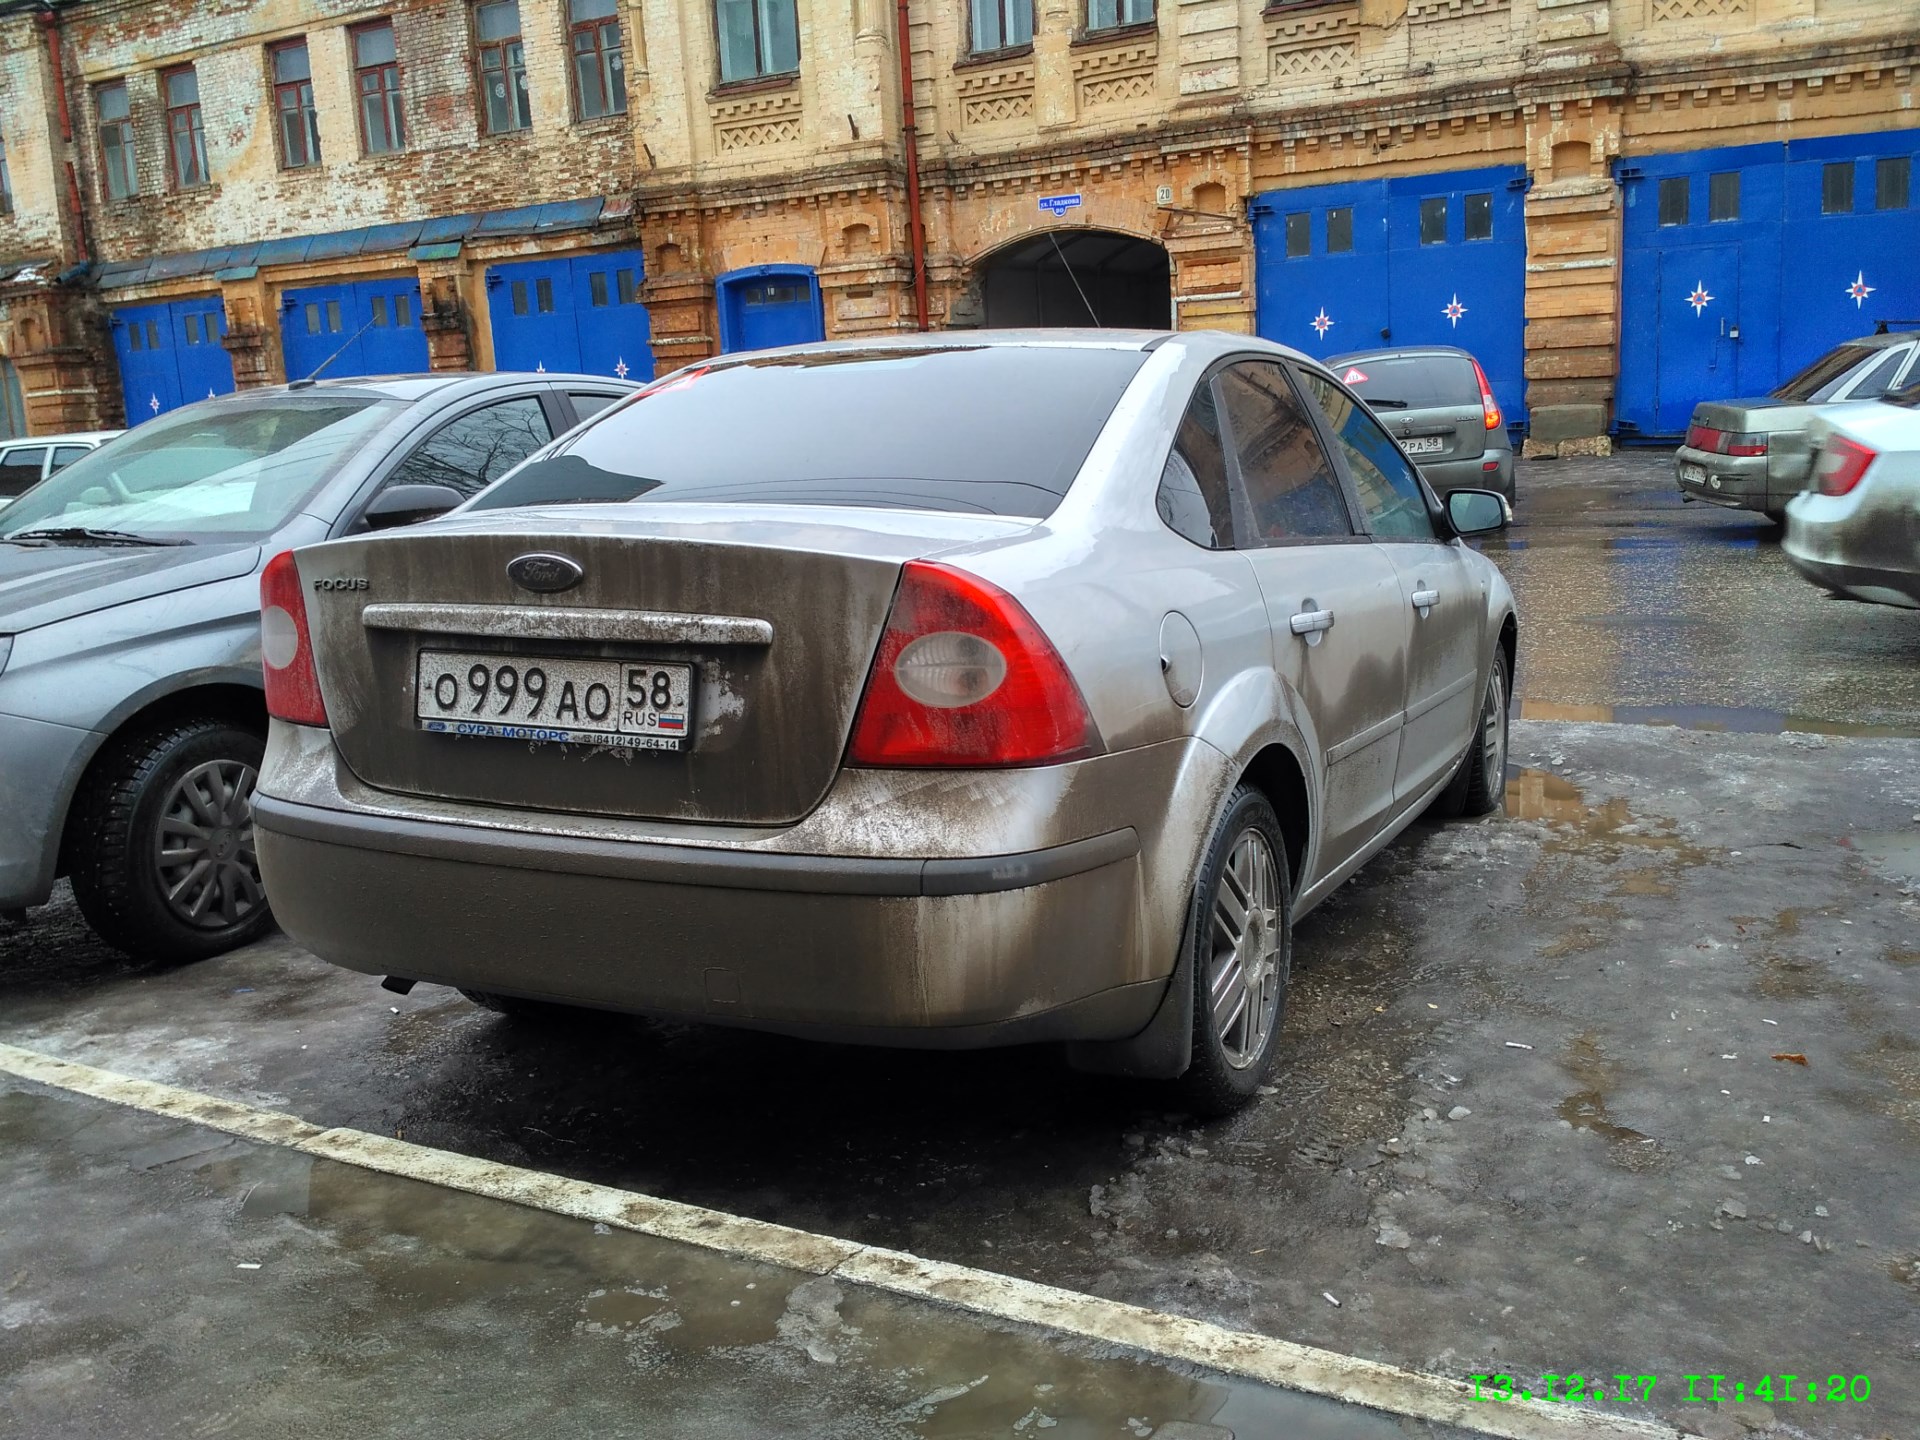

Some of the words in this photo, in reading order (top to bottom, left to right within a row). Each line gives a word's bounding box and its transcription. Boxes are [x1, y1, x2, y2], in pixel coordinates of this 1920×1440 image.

[1160, 189, 1170, 199] 20
[1049, 198, 1080, 207] Гладкова
[1426, 437, 1439, 447] 58
[313, 577, 370, 591] FOCUS
[626, 668, 672, 711] 58
[623, 711, 657, 727] RUS
[457, 723, 570, 742] СУРА-МОТОРС
